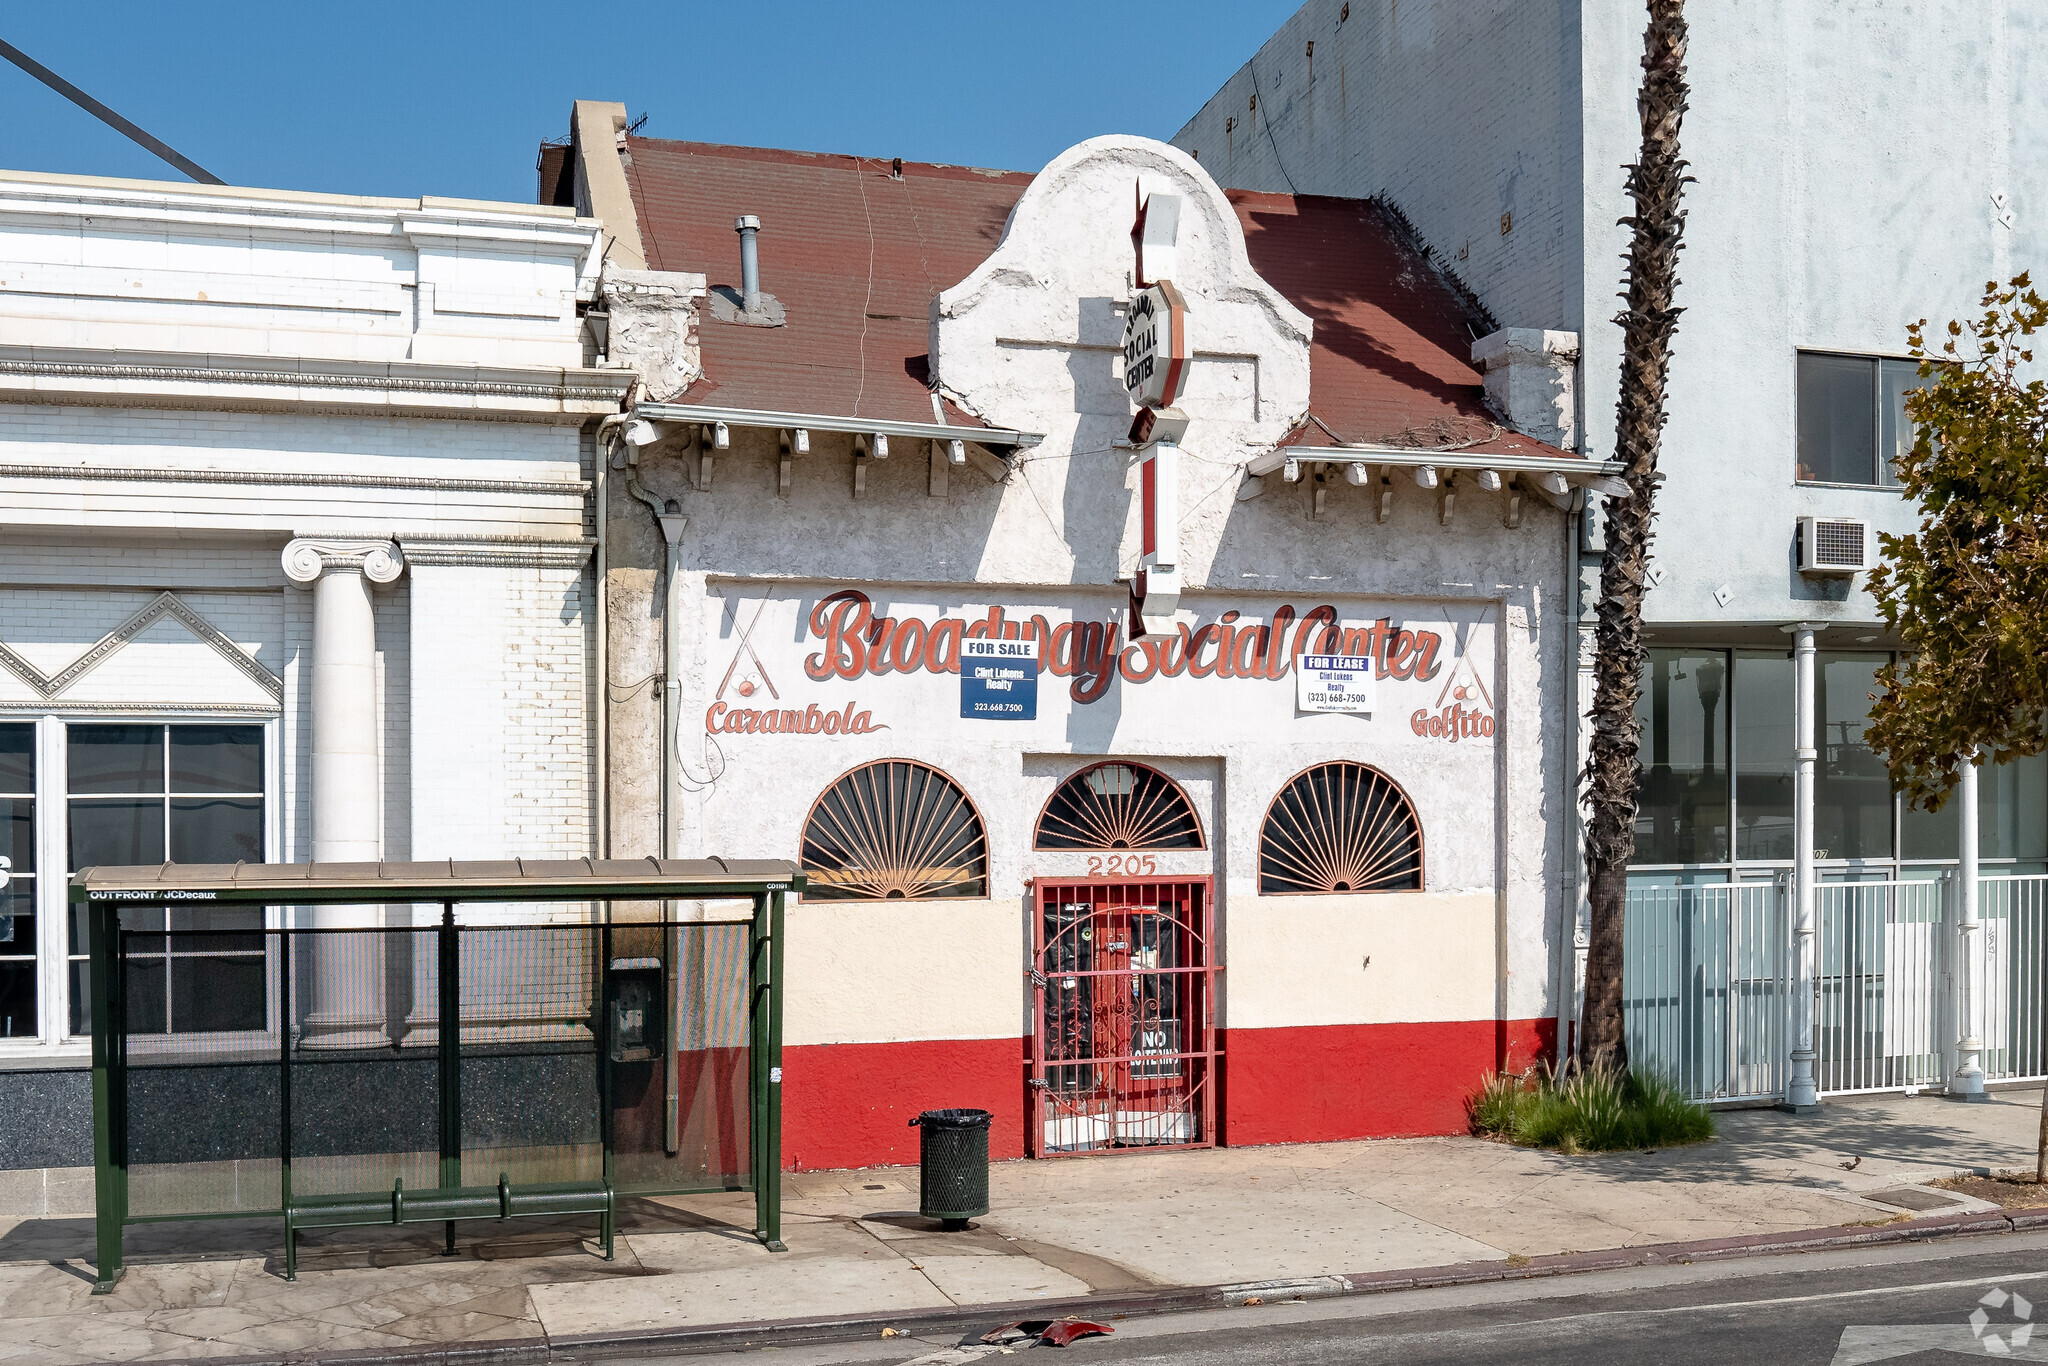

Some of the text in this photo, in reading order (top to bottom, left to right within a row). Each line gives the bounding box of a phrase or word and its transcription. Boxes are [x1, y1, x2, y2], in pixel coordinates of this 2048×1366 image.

[1123, 323, 1157, 368] SOCIAL
[1126, 353, 1154, 392] CENTER
[968, 642, 1031, 656] FOR SALE
[1308, 657, 1364, 670] FOR LEASE
[974, 666, 1025, 679] Clint Lukens
[1319, 671, 1353, 681] Clint Lukens
[985, 678, 1013, 691] Realty
[1328, 683, 1345, 692] Realty
[1308, 692, 1366, 703] (323) 668-7500
[974, 702, 1023, 712] 323.668.7500
[705, 700, 892, 735] Carambola
[1410, 702, 1496, 743] Golfito
[1087, 854, 1157, 877] 2205
[90, 890, 158, 899] OUTFRONT
[163, 890, 217, 899] JCDecaux
[1142, 1030, 1167, 1048] NO
